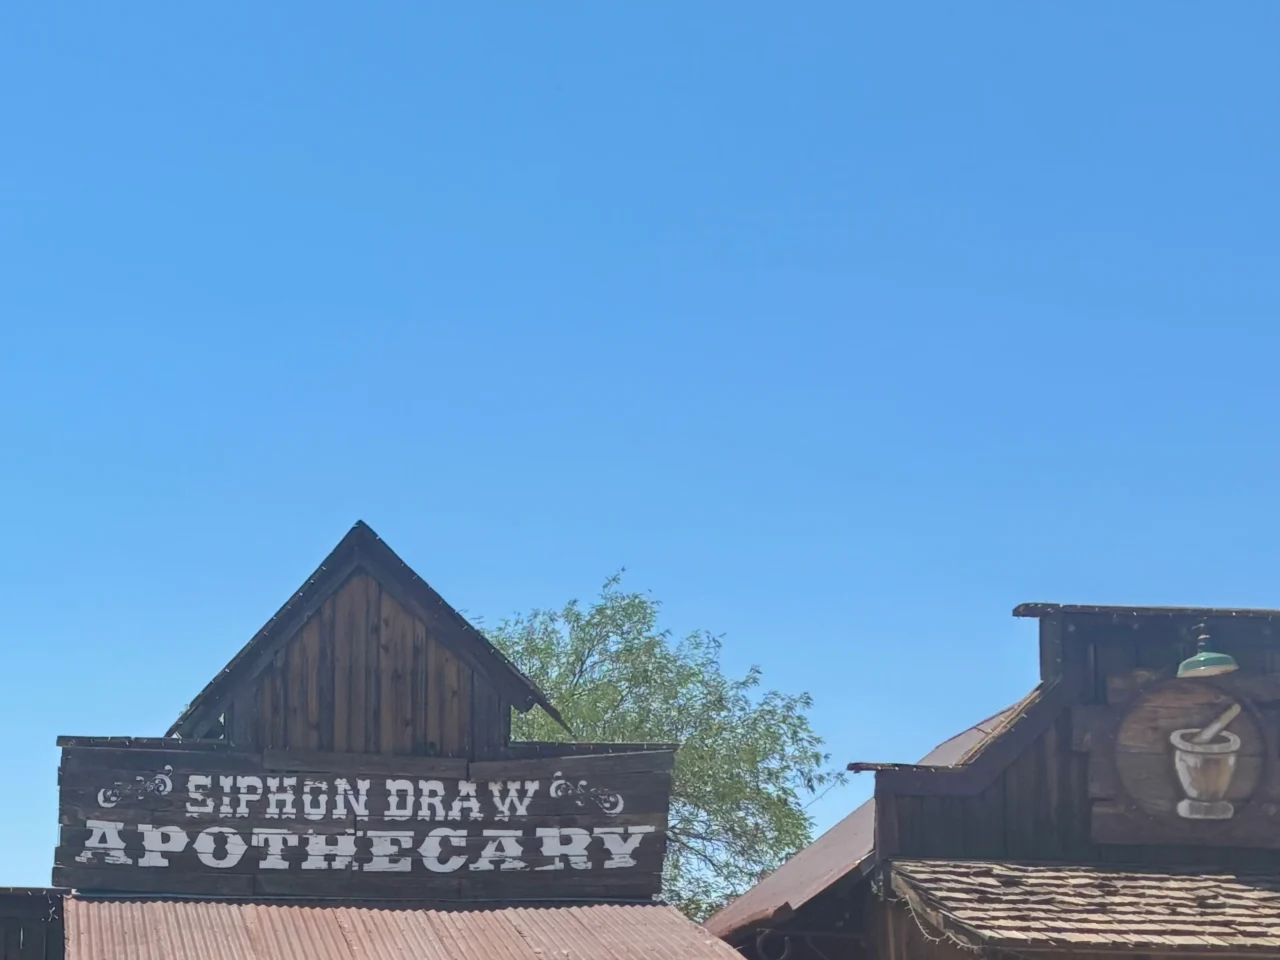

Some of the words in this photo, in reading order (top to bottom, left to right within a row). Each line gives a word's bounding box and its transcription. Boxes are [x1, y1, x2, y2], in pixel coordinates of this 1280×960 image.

[185, 774, 369, 821] SIPHON
[383, 776, 540, 822] DRAW
[74, 819, 655, 872] APOTHECARY
